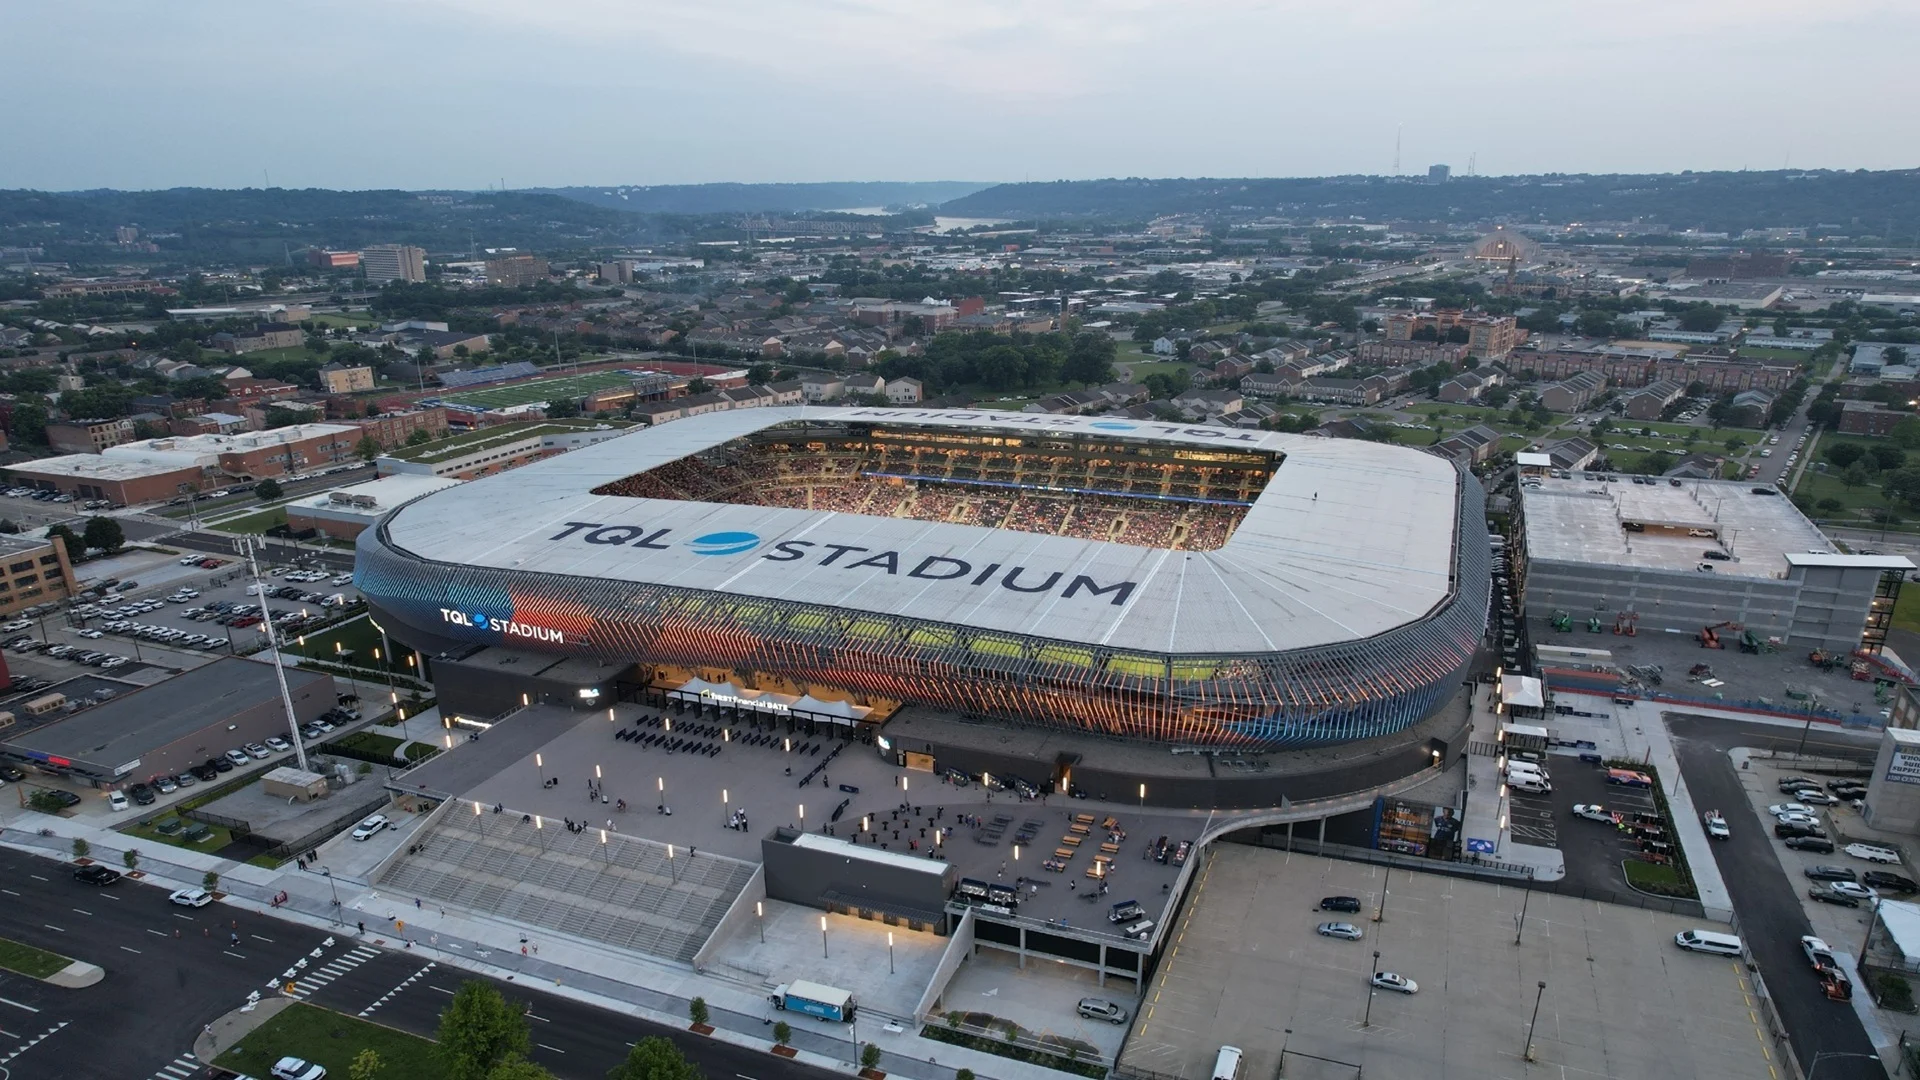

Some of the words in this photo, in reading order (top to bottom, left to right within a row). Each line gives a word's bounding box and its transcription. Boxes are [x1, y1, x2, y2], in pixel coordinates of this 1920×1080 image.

[851, 410, 1081, 426] STADIUM
[1151, 425, 1260, 442] TQL
[548, 522, 671, 550] TQL
[761, 540, 1137, 605] STADIUM
[440, 608, 473, 626] TQL
[490, 618, 564, 644] STADIUM
